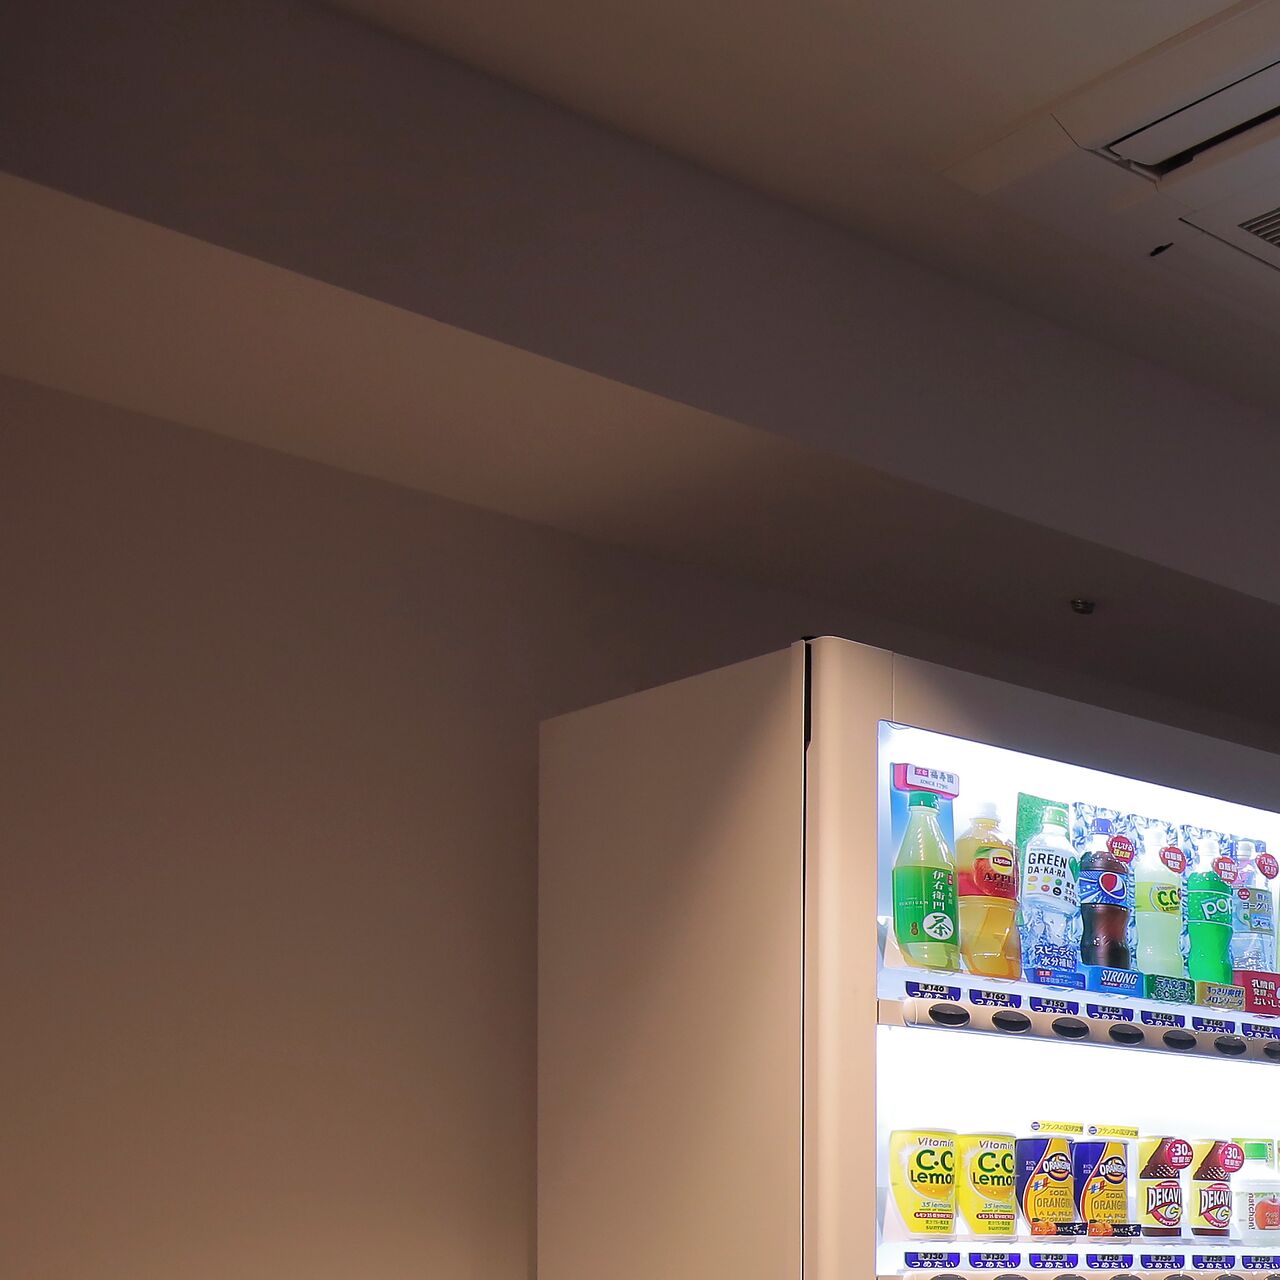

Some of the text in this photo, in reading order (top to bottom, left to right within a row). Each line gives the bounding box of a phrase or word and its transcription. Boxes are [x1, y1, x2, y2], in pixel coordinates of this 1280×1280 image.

[1028, 852, 1067, 869] GREEN
[932, 871, 945, 911] 伊右衛門
[927, 914, 953, 938] 茶
[1101, 969, 1138, 985] STRONG
[911, 1260, 955, 1269] つめたい
[974, 1261, 1017, 1269] つめたい
